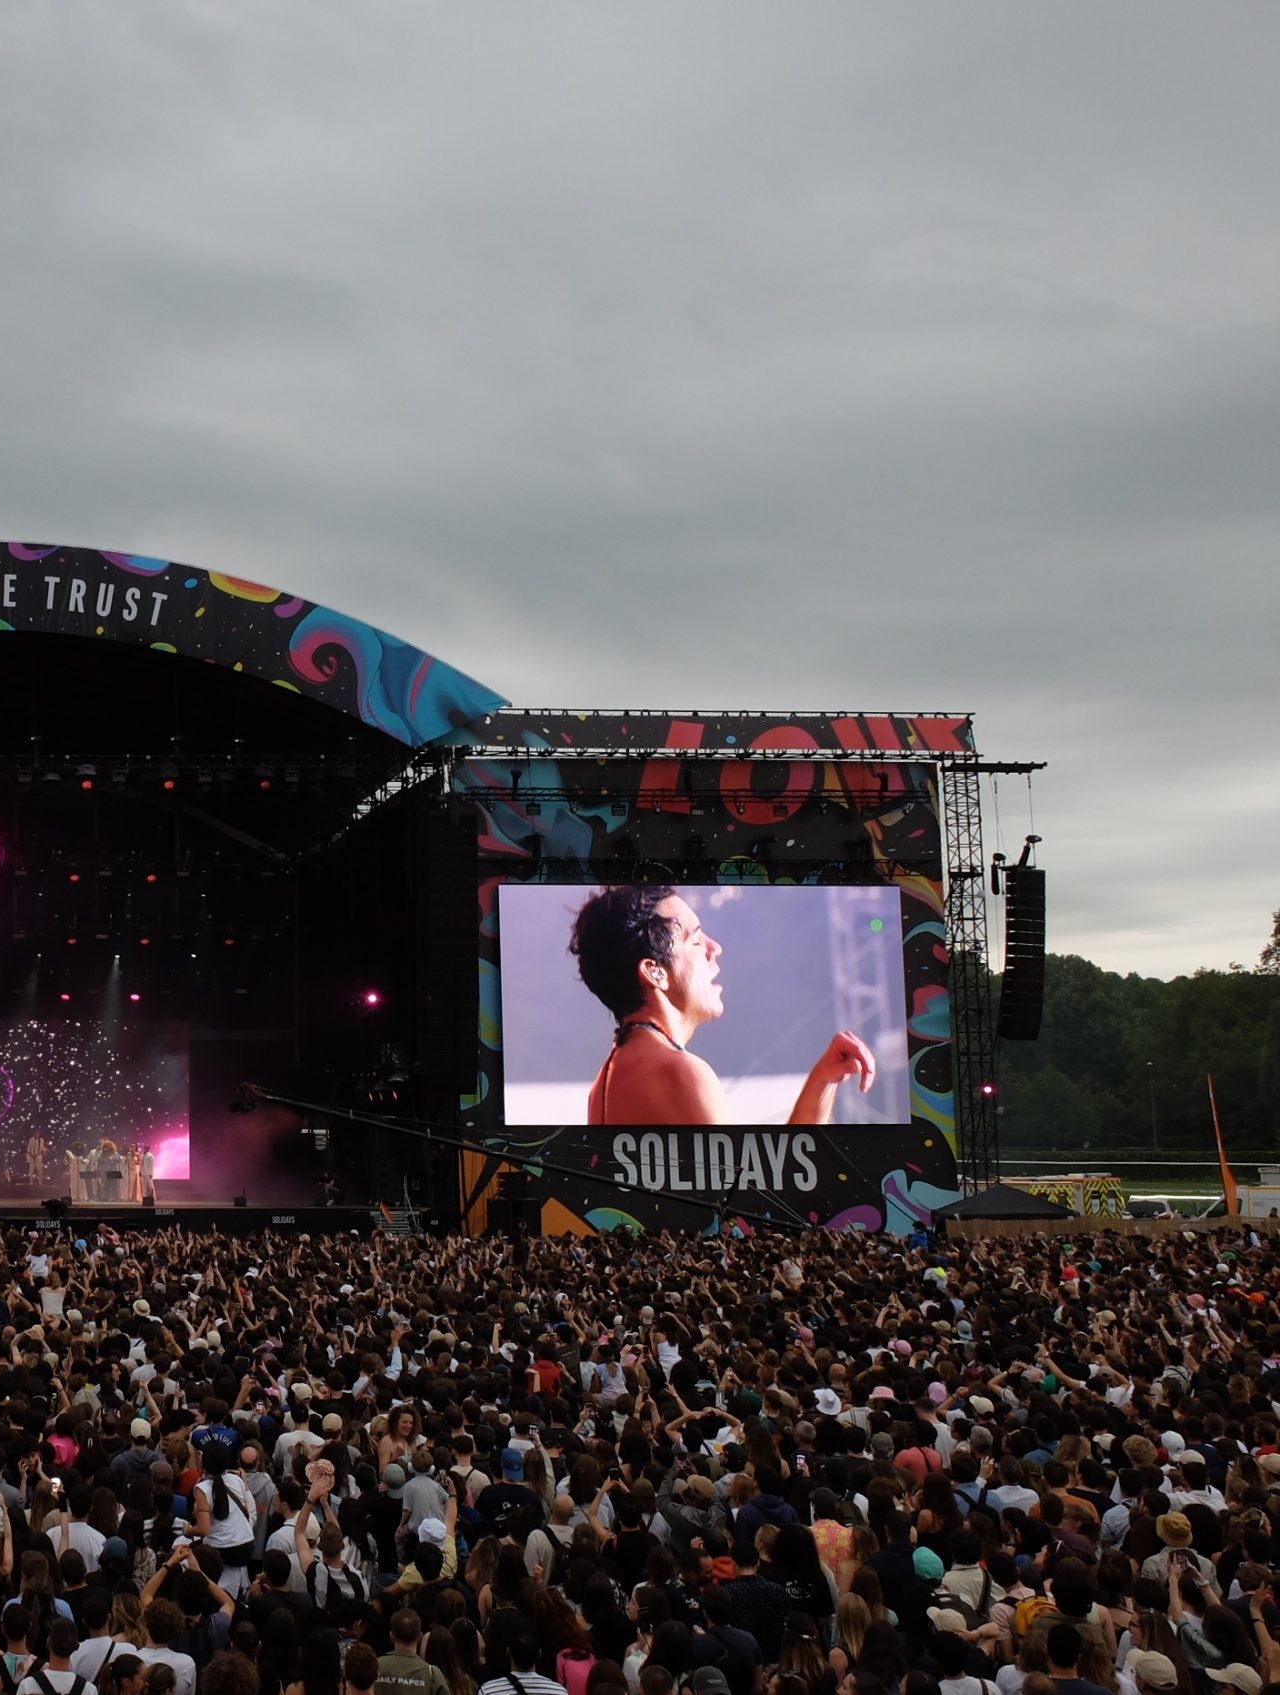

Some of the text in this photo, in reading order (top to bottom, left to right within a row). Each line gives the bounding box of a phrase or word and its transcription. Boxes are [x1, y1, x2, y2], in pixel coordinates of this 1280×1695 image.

[43, 575, 169, 626] TRUST
[612, 1133, 817, 1193] SOLIDAYS
[397, 1677, 426, 1687] PAPER
